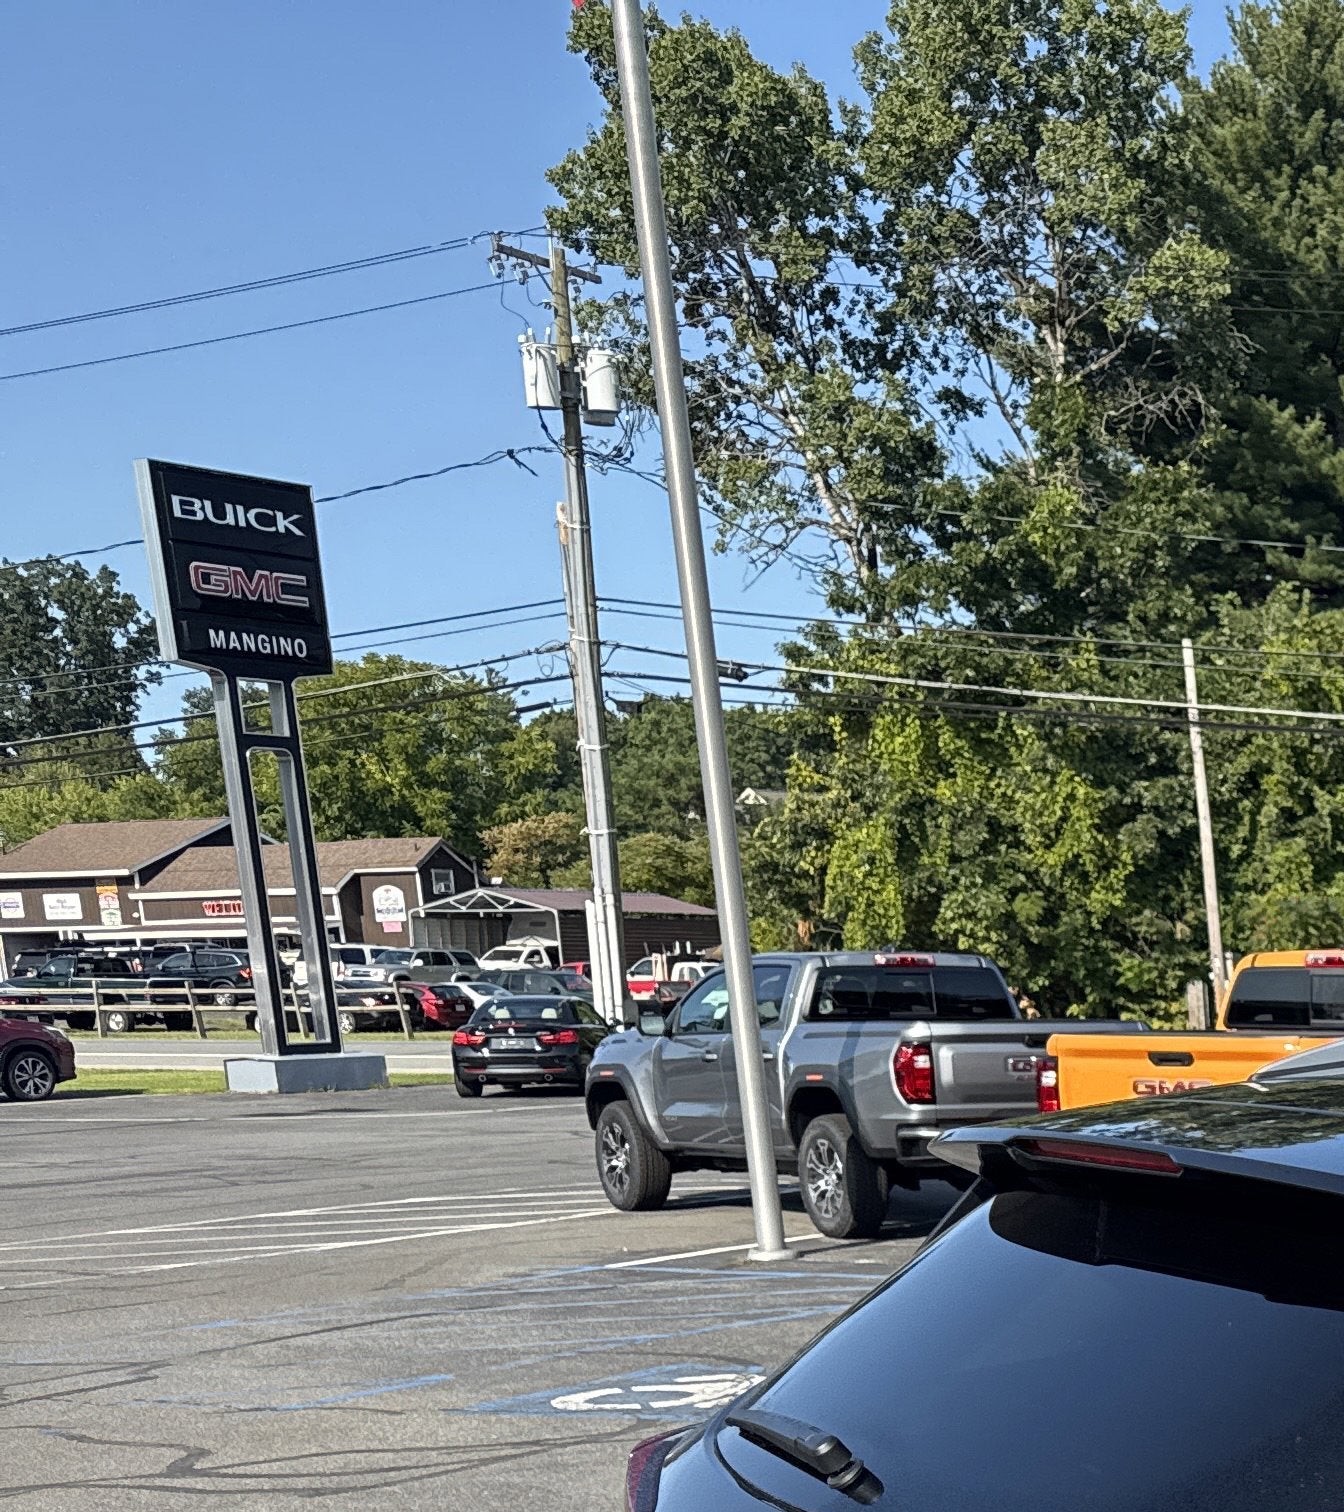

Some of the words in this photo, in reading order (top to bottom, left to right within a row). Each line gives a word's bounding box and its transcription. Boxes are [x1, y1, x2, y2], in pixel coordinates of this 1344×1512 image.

[171, 494, 306, 537] BUICK
[189, 561, 310, 607] GMC
[208, 628, 307, 658] MANGINO
